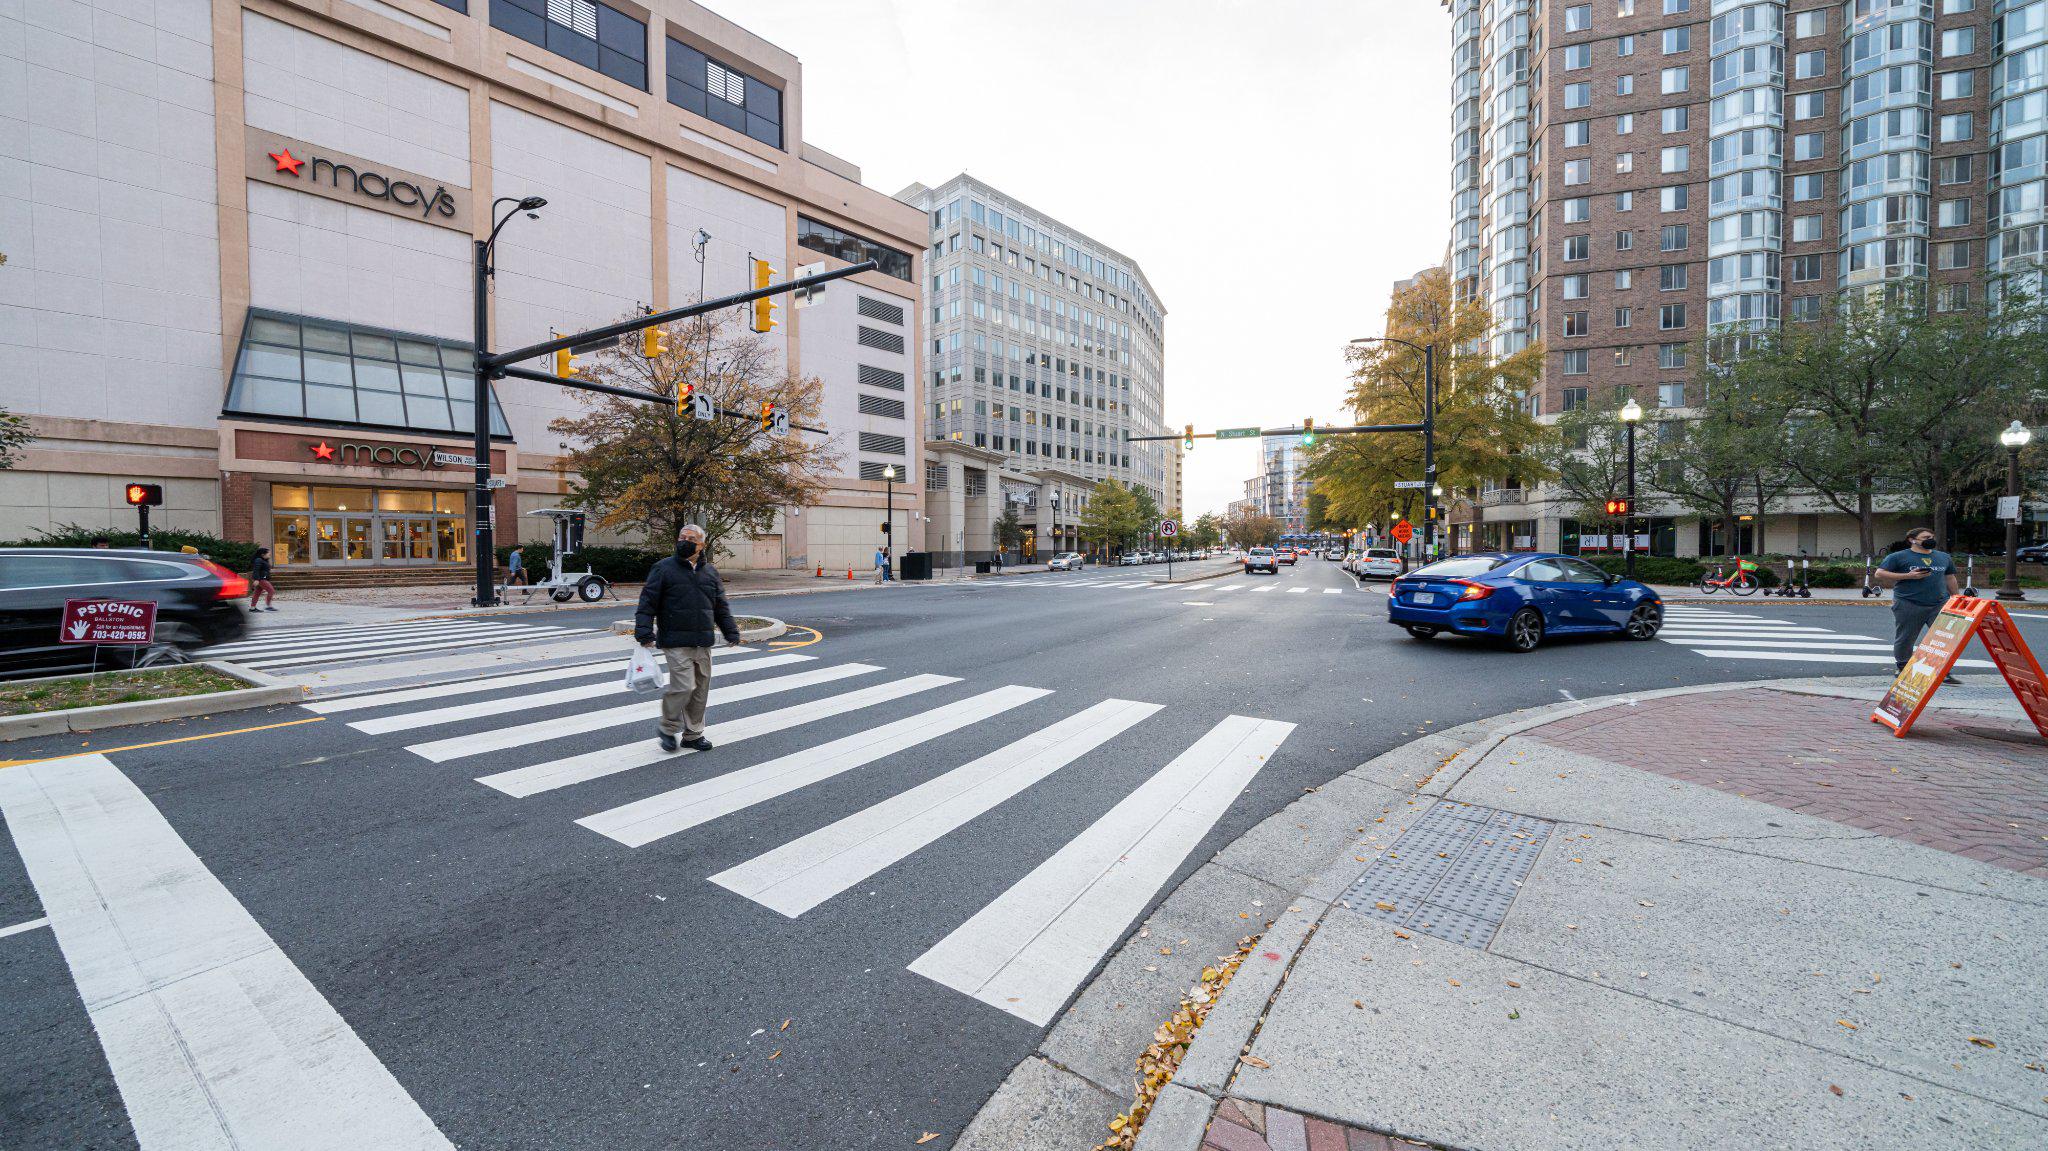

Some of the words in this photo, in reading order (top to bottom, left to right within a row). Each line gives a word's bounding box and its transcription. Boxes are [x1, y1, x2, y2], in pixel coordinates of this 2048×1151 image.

[312, 156, 456, 218] macy's
[697, 410, 711, 418] ONLY
[436, 453, 463, 465] WILSON
[77, 602, 144, 618] PSYCHIC
[93, 631, 147, 640] 703-420-0592
